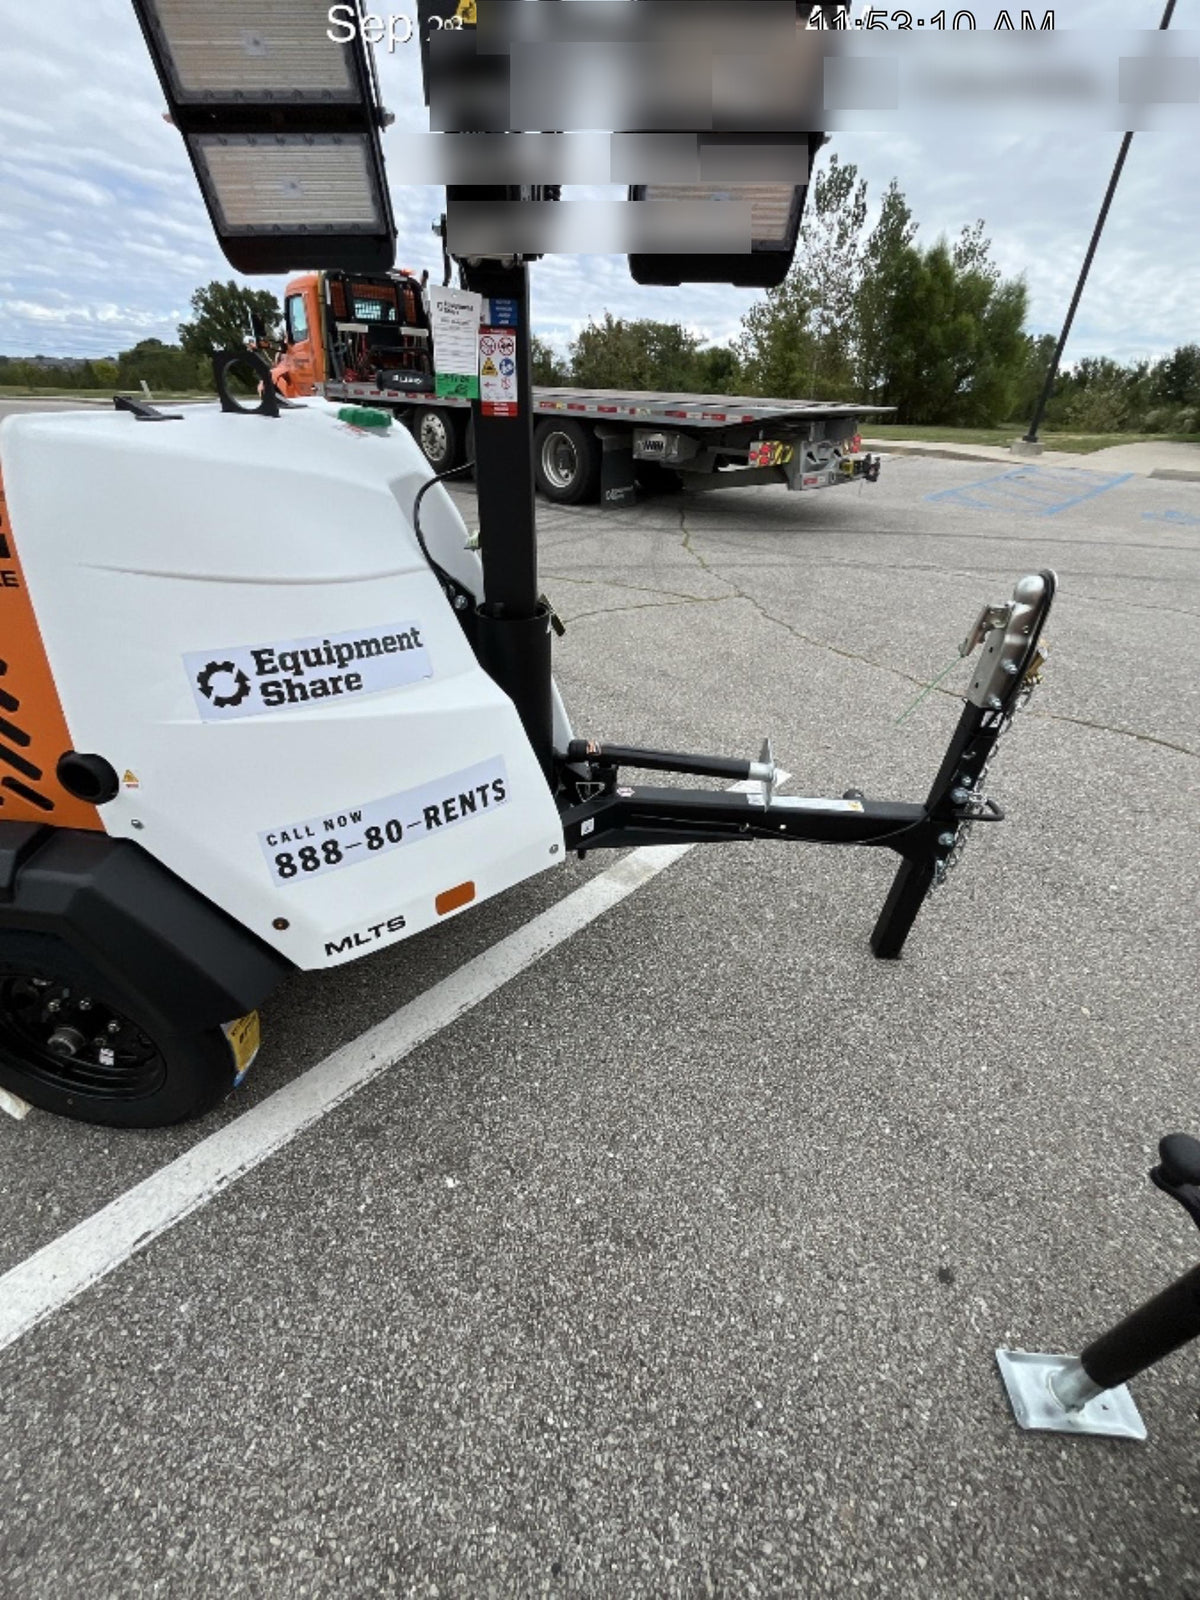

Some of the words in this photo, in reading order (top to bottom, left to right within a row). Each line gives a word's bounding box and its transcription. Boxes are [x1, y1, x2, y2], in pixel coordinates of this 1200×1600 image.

[250, 627, 423, 676] Equipment
[259, 672, 363, 707] Share
[266, 826, 315, 847] CALL
[323, 810, 363, 832] NOW
[275, 778, 506, 879] 888-80-RENTS
[324, 915, 407, 956] MLTS
